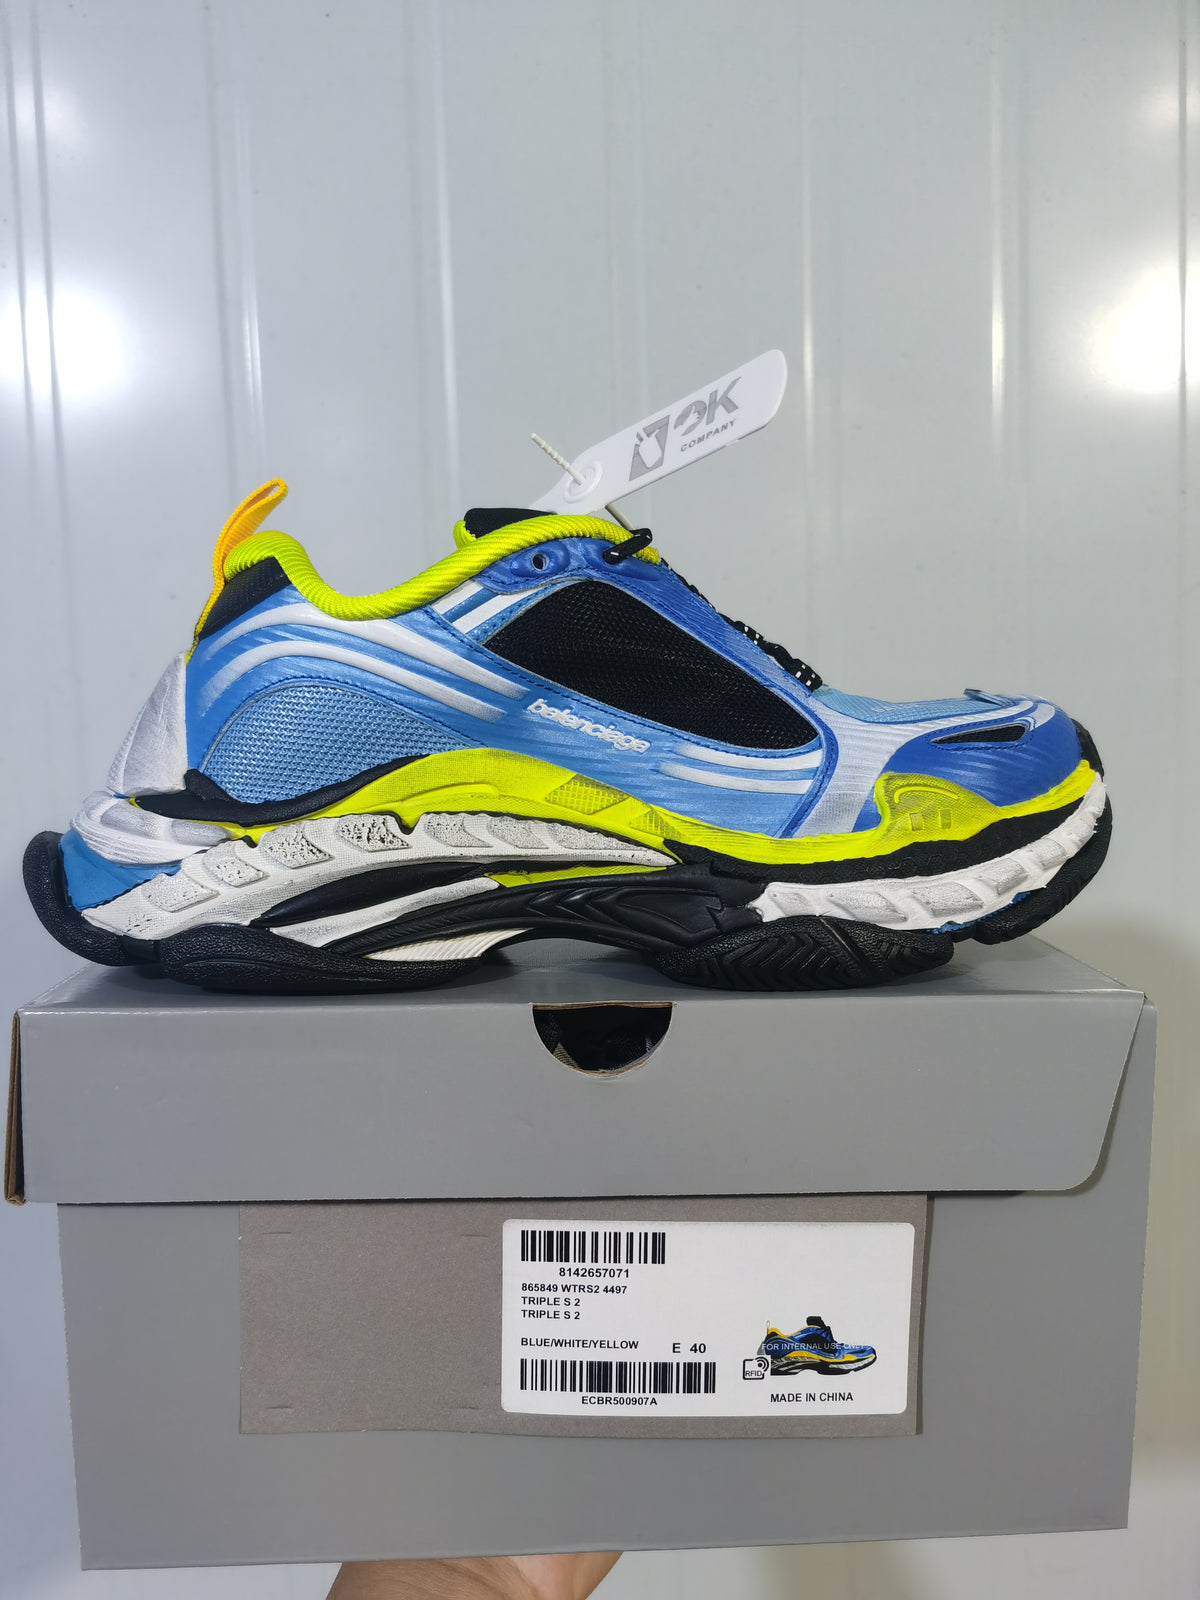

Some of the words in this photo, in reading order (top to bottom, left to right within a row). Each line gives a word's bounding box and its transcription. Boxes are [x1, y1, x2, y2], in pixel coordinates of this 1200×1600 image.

[680, 418, 737, 452] COMPANY
[526, 698, 651, 754] balenciaga
[558, 1267, 629, 1278] 8142657071
[521, 1283, 558, 1293] 865849
[561, 1284, 600, 1294] WTRS2
[602, 1285, 628, 1294] 4497
[521, 1296, 560, 1306] TRIPLE
[563, 1297, 571, 1306] S
[574, 1298, 581, 1307] 2
[521, 1309, 560, 1319] TRIPLE
[563, 1311, 571, 1320] S
[574, 1311, 581, 1320] 2
[520, 1337, 639, 1349] BLUE/WHITE/YELLOW
[672, 1343, 681, 1353] E
[689, 1343, 707, 1354] 40
[761, 1343, 779, 1351] FOR
[782, 1342, 822, 1350] INTERNAL
[824, 1342, 841, 1350] USE
[581, 1395, 658, 1406] ECBR500907A
[770, 1393, 802, 1402] MADE
[805, 1392, 816, 1402] IN
[819, 1392, 854, 1401] CHINA
